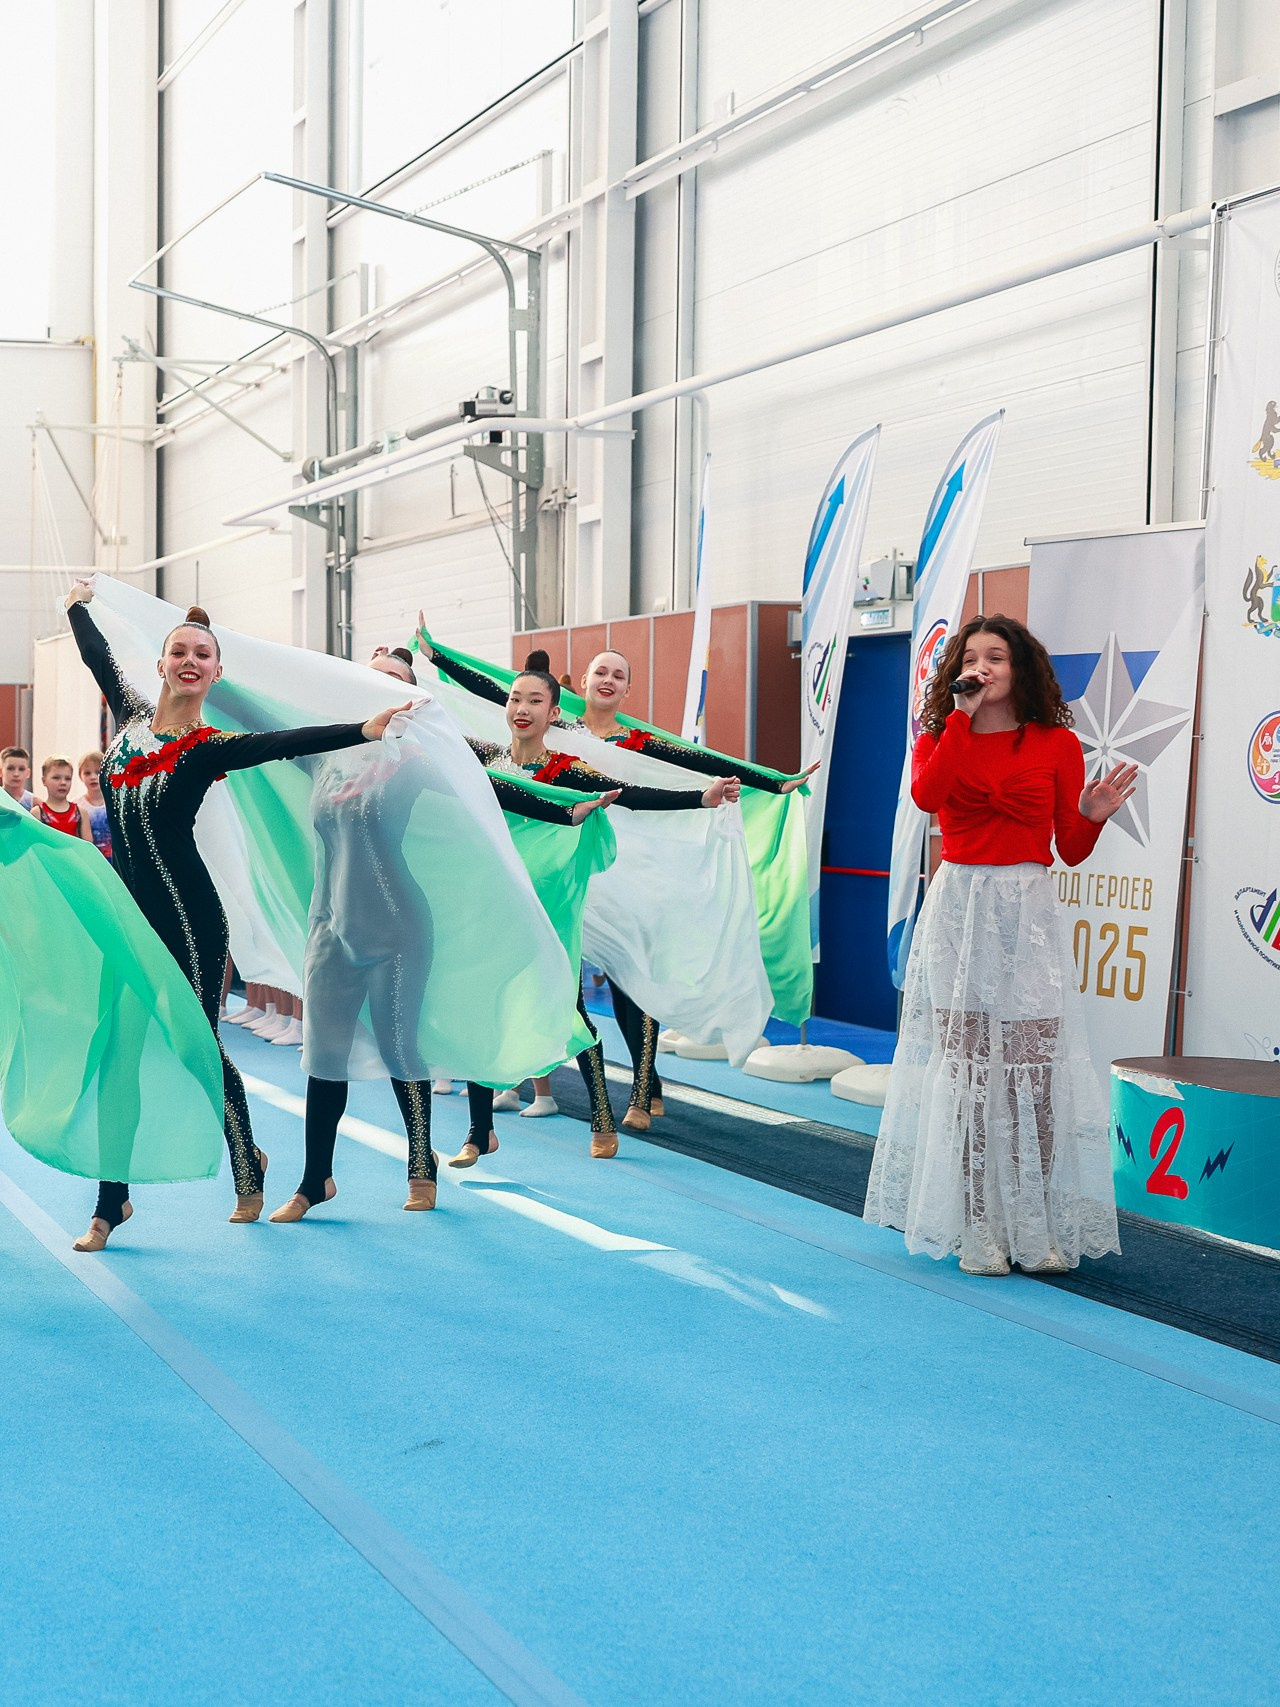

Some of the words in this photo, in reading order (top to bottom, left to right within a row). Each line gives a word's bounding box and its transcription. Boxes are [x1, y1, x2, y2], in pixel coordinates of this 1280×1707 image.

[1086, 873, 1153, 912] ГЕРОЕВ
[1234, 886, 1267, 901] ДЕПАРТАМЕНТ
[1073, 919, 1148, 1002] 025
[1146, 1106, 1189, 1201] 2
